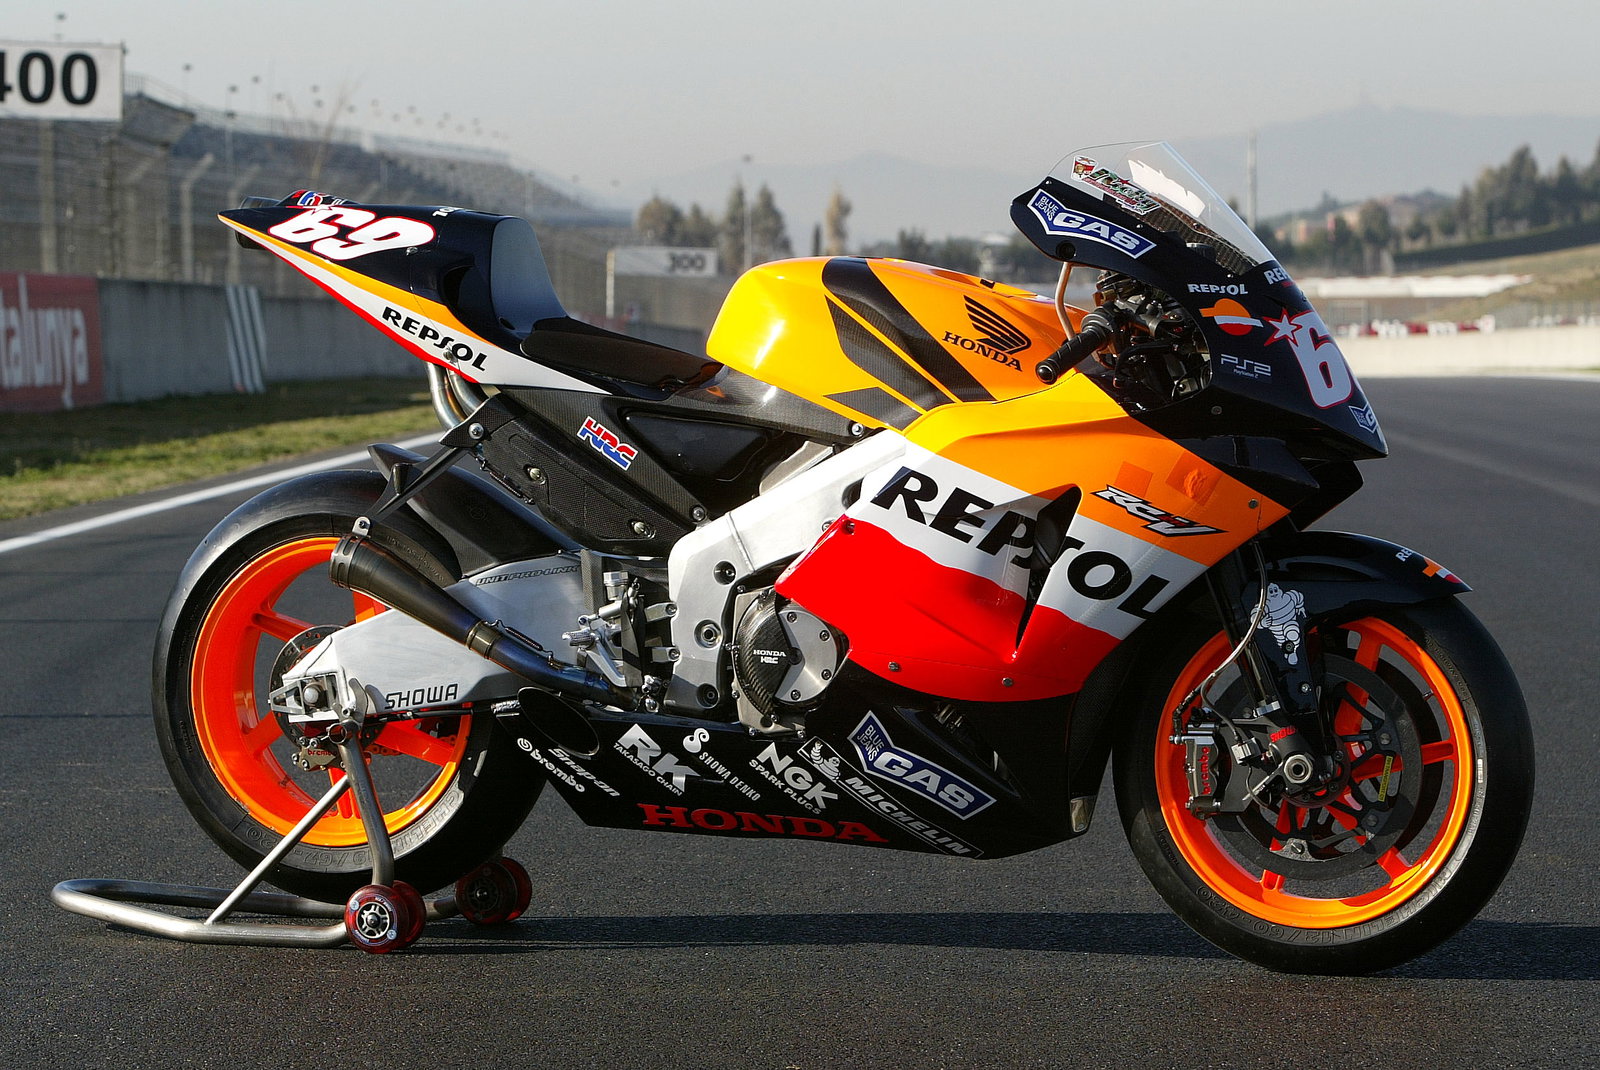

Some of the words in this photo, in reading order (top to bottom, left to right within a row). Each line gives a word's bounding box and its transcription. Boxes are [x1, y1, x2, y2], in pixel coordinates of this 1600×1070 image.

[0, 50, 98, 106] 00
[1035, 202, 1055, 221] JEANS
[1040, 196, 1059, 213] BLUE
[267, 205, 436, 261] 69
[1053, 212, 1140, 250] GAS
[1187, 283, 1248, 295] REPSOL
[382, 306, 488, 371] REPSOL
[941, 331, 1023, 372] HONDA
[1220, 353, 1271, 377] PS2
[576, 416, 638, 471] HRC
[476, 574, 509, 587] UNIT
[753, 649, 787, 657] HONDA
[385, 683, 459, 709] SHOWA
[617, 723, 700, 792] RK
[856, 733, 878, 761] JEANS
[864, 724, 885, 752] BLUE
[530, 749, 586, 793] brembo
[548, 748, 621, 797] Snap-on
[613, 742, 656, 777] TAKASAGO
[656, 776, 683, 797] CHAIN
[699, 752, 731, 782] SHOWA
[730, 776, 761, 801] DENKO
[749, 759, 786, 789] SPARK
[783, 789, 822, 815] PLUGS
[756, 742, 838, 809] NGK
[873, 751, 975, 809] GAS
[1198, 746, 1212, 795] brembo
[388, 785, 463, 856] CHELIN
[637, 803, 890, 843] HONDA
[845, 776, 972, 855] MICHELIN
